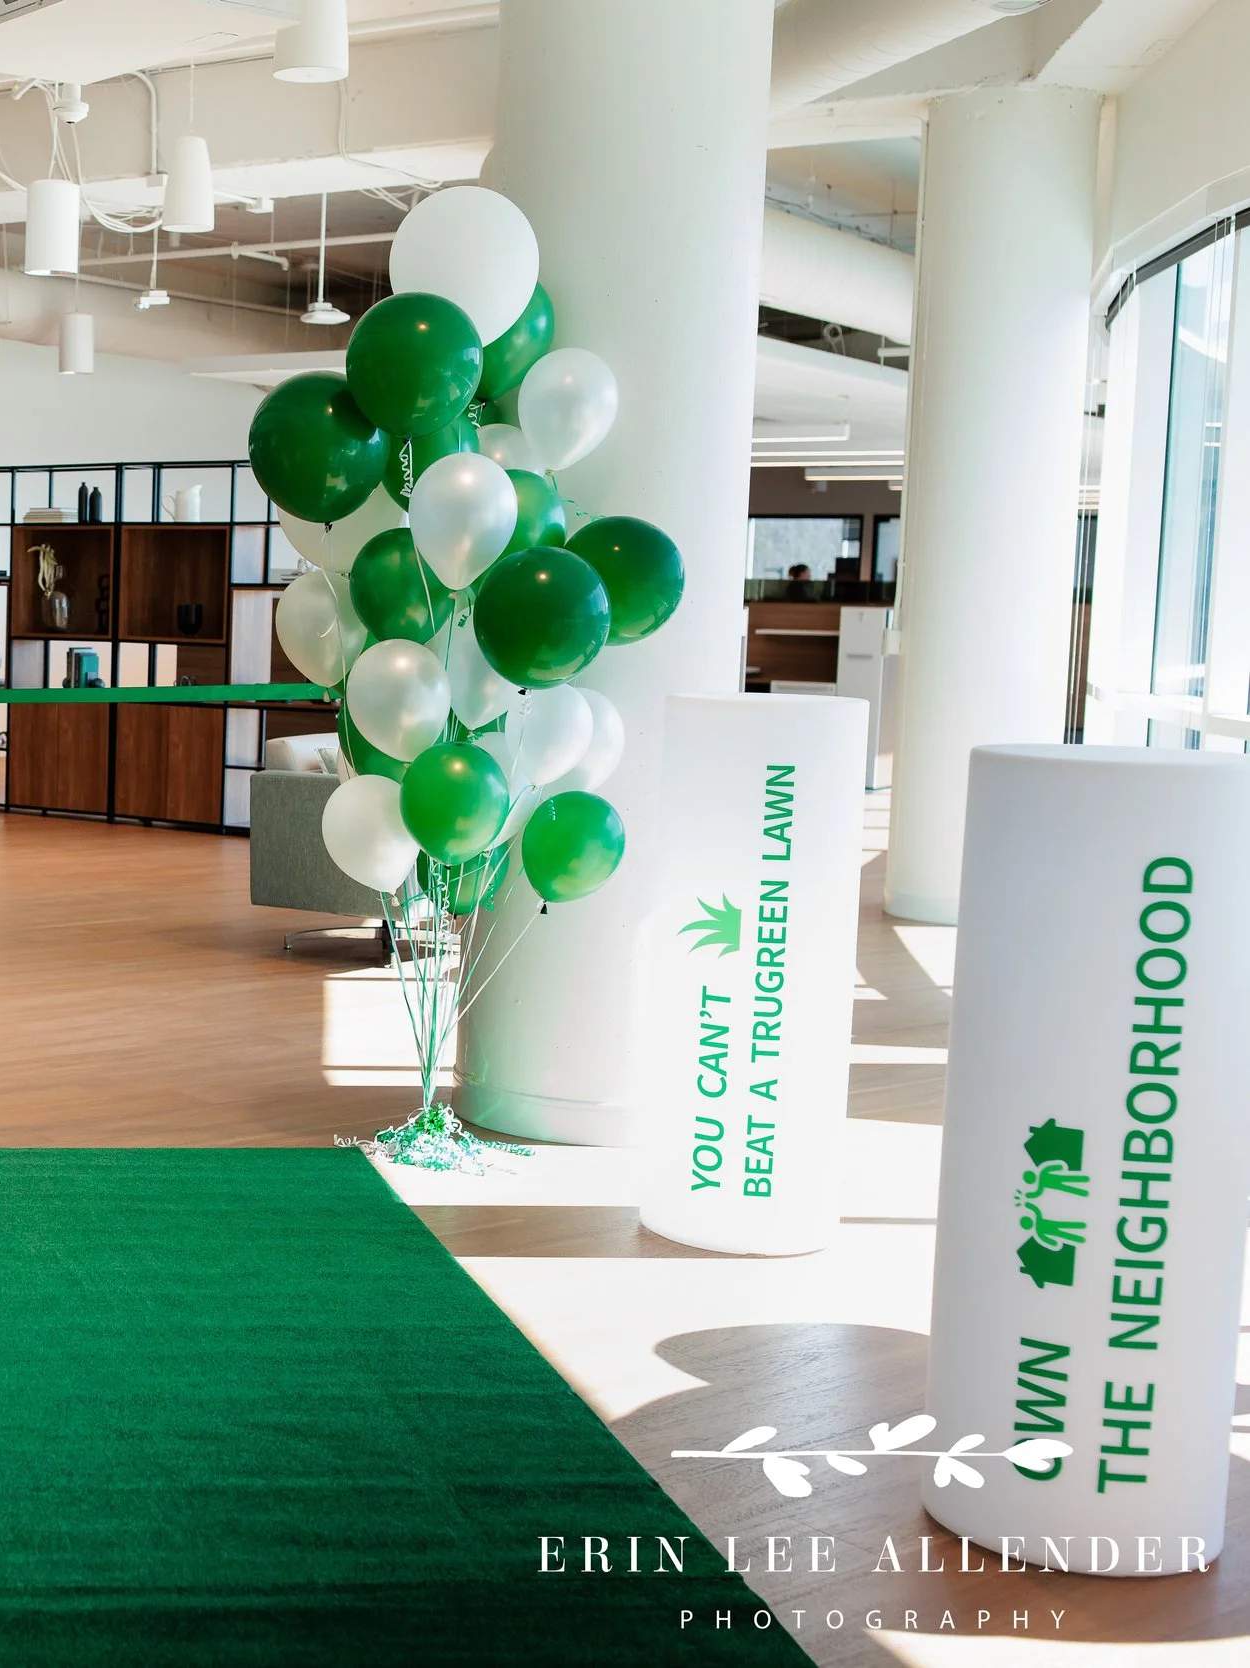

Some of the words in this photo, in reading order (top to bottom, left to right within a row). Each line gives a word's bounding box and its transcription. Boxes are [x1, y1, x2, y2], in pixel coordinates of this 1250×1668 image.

[760, 764, 797, 862] LAWN
[751, 879, 790, 1064] TRUGREEN
[696, 985, 732, 1099] CAN’T
[749, 1078, 779, 1102] A
[690, 1115, 725, 1192] YOU
[742, 1113, 776, 1198] BEAT
[1108, 855, 1194, 1351] NEIGHBORHOOD
[1097, 1380, 1157, 1494] THE
